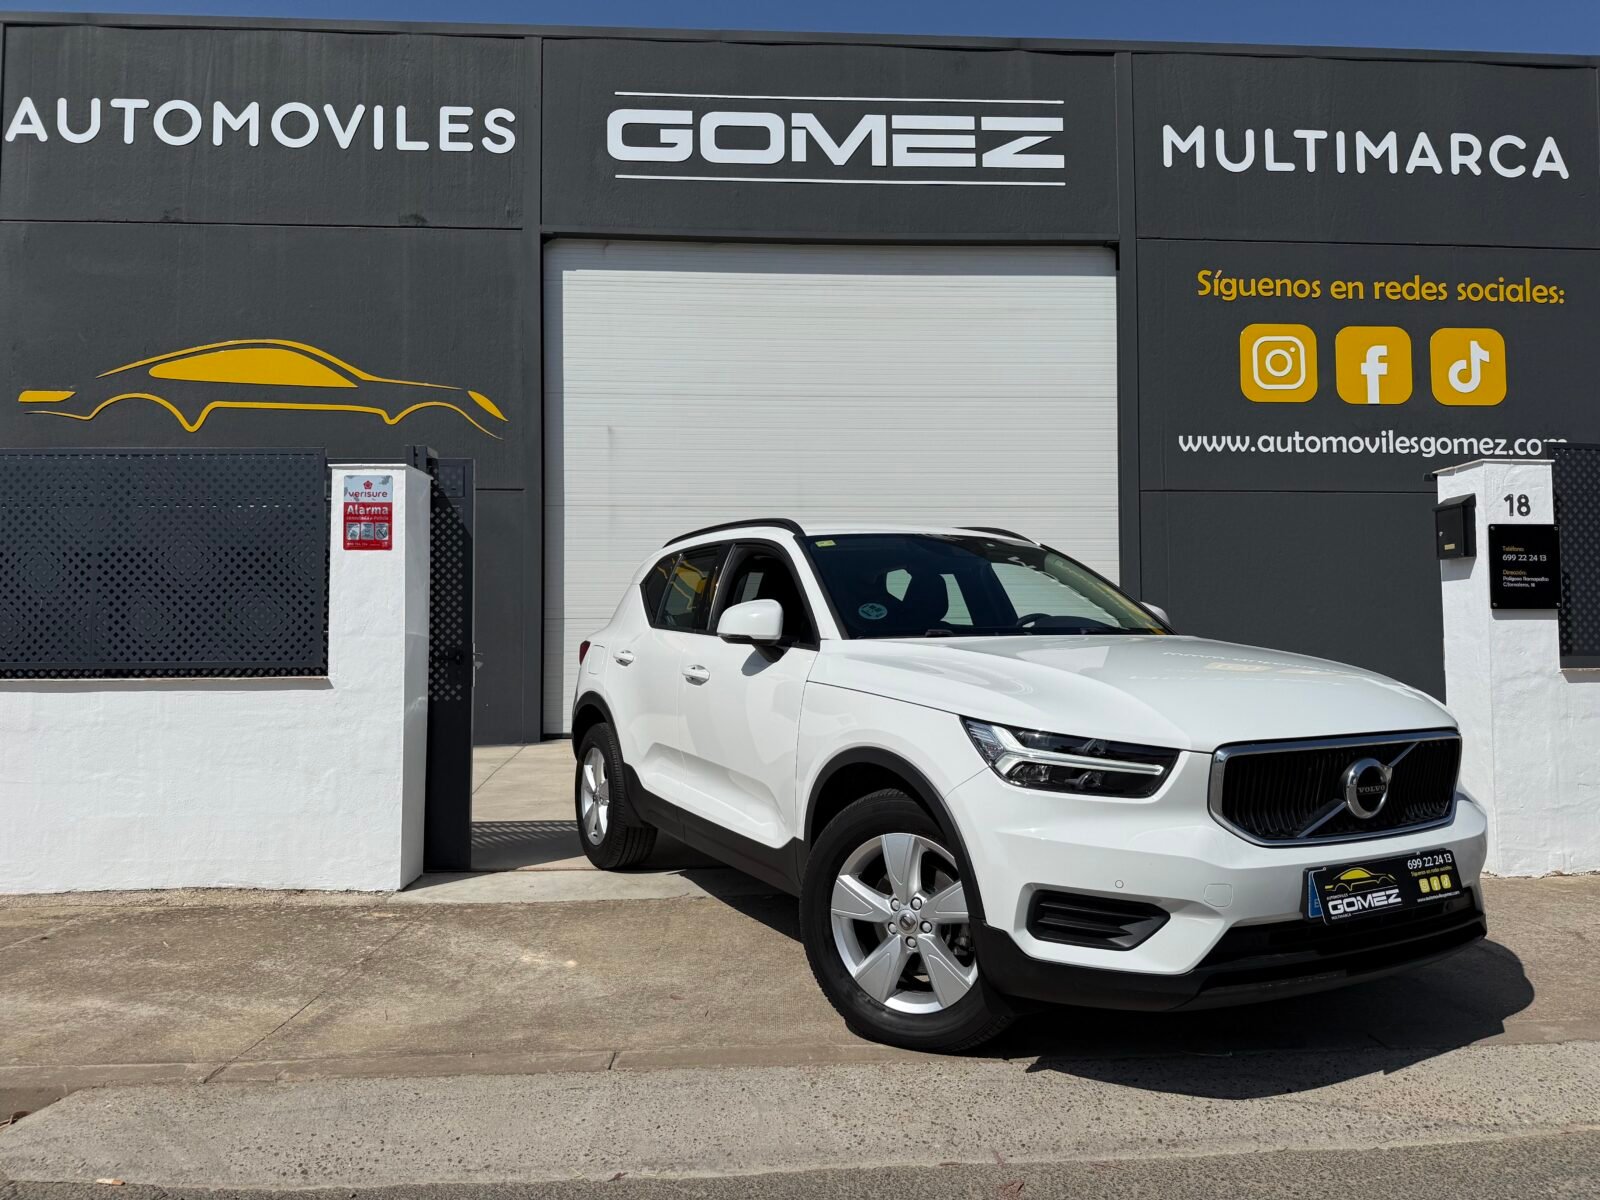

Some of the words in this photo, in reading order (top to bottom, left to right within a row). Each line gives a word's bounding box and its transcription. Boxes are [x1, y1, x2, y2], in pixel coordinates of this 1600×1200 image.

[5, 97, 516, 154] AUTOMOVILES
[607, 109, 1065, 168] GOMEZ
[1163, 124, 1569, 180] MULTIMARCA
[1197, 269, 1321, 301] Síguenos
[1330, 280, 1364, 300] en
[1374, 275, 1448, 301] redes
[1457, 276, 1565, 304] sociales:
[1178, 430, 1567, 458] www.automovilesgomez.co
[348, 490, 388, 498] verisure
[1503, 493, 1531, 517] 18
[347, 504, 389, 515] Alarma
[1357, 784, 1386, 793] VOLVO
[1407, 858, 1422, 870] 699
[1423, 856, 1434, 867] 22
[1434, 854, 1444, 865] 24
[1444, 853, 1453, 863] 13
[1327, 888, 1402, 915] GOMEZ
